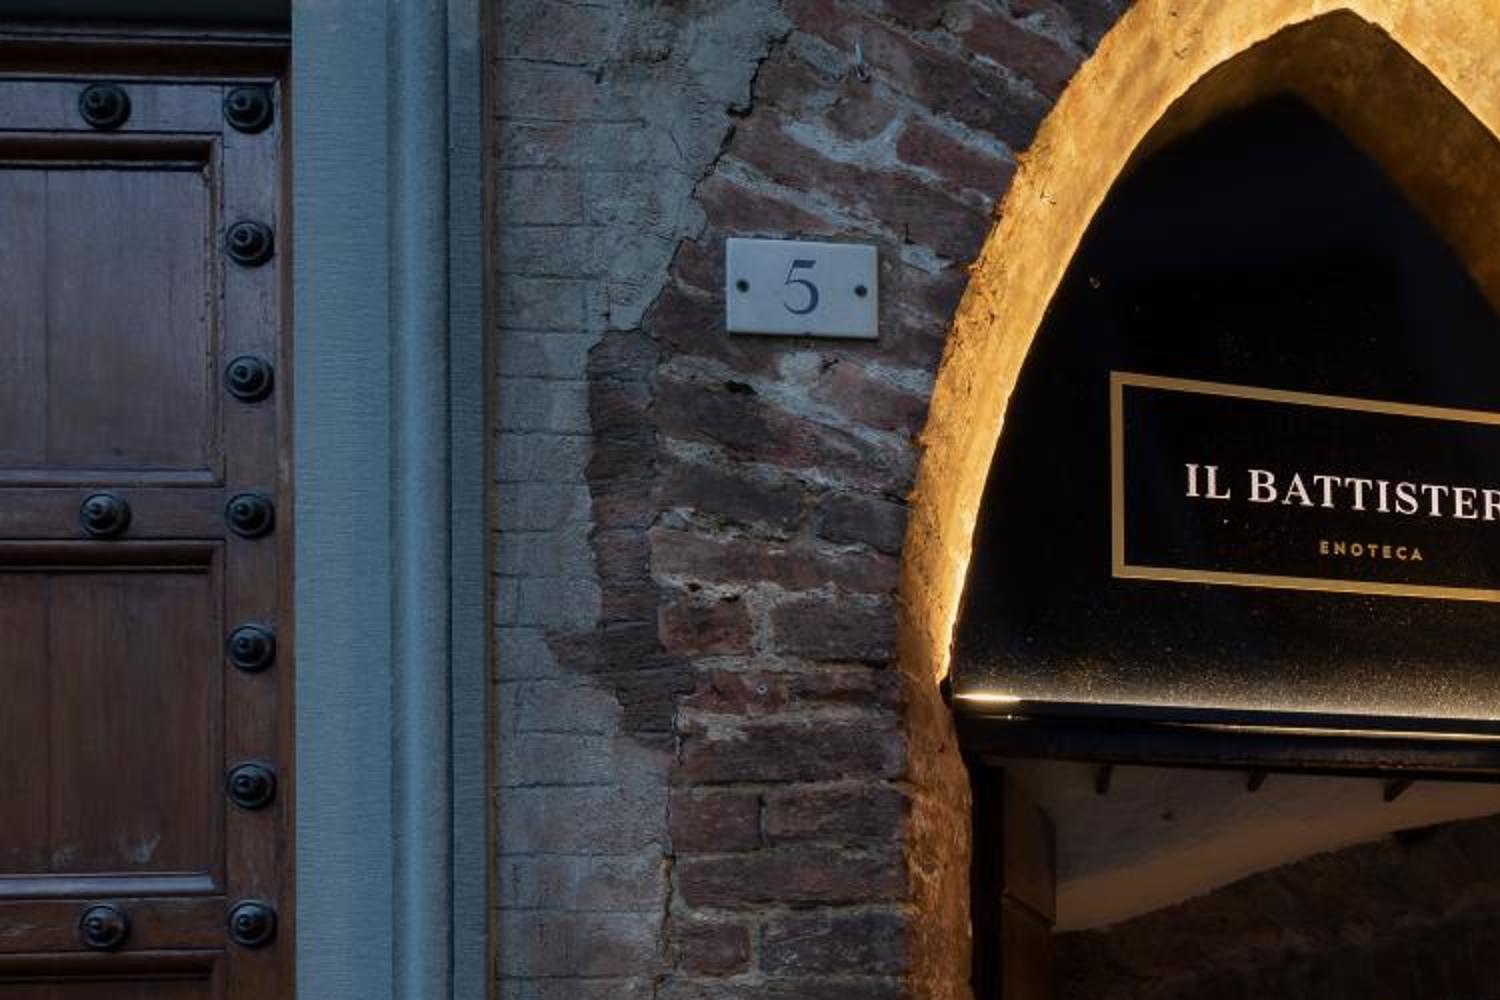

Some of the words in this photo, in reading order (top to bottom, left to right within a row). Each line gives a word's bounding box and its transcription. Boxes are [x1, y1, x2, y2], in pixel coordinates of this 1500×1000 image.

[784, 259, 819, 315] 5
[1185, 463, 1231, 500] IL
[1319, 540, 1424, 561] ENOTECA
